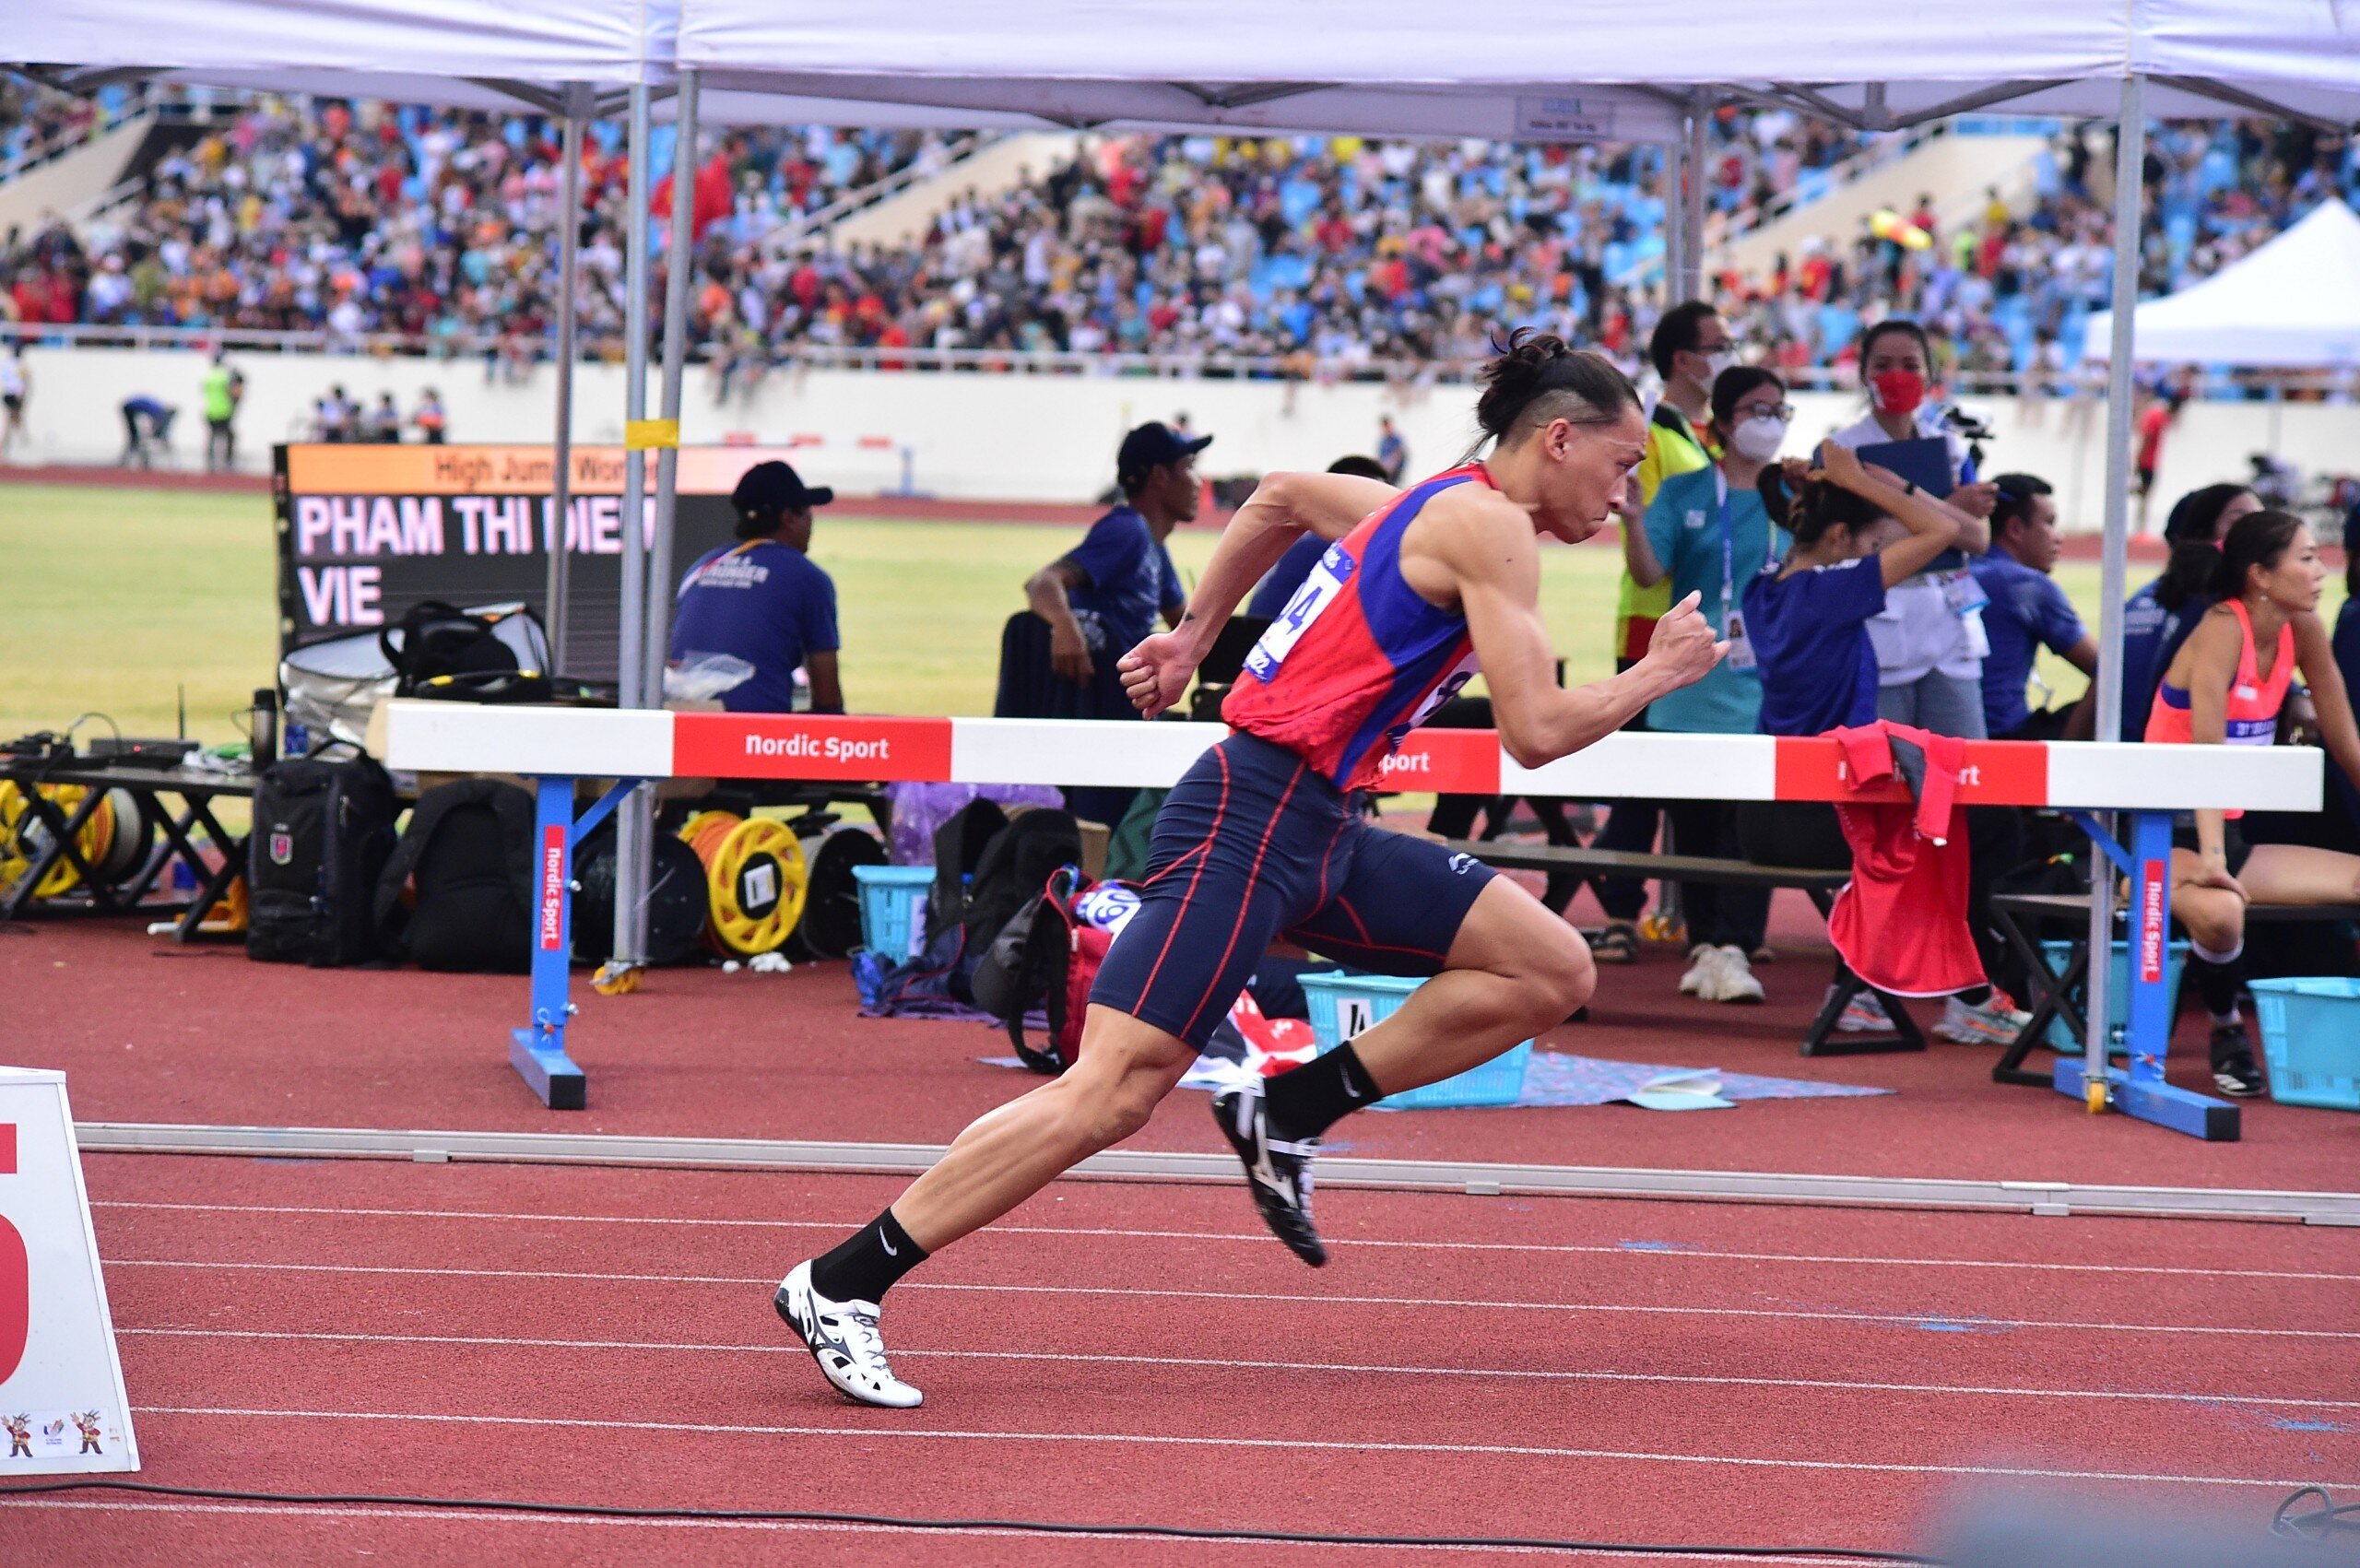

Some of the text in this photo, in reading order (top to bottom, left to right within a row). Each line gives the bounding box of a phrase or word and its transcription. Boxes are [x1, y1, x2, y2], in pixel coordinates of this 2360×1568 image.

[435, 452, 493, 492] High
[502, 452, 555, 482] Jum
[297, 495, 444, 555] PHAM
[452, 495, 533, 555] THI
[297, 565, 385, 627] VIE
[824, 736, 890, 763] Sport
[1377, 751, 1430, 775] port
[541, 897, 560, 939] Sport
[2142, 931, 2161, 972] Sport
